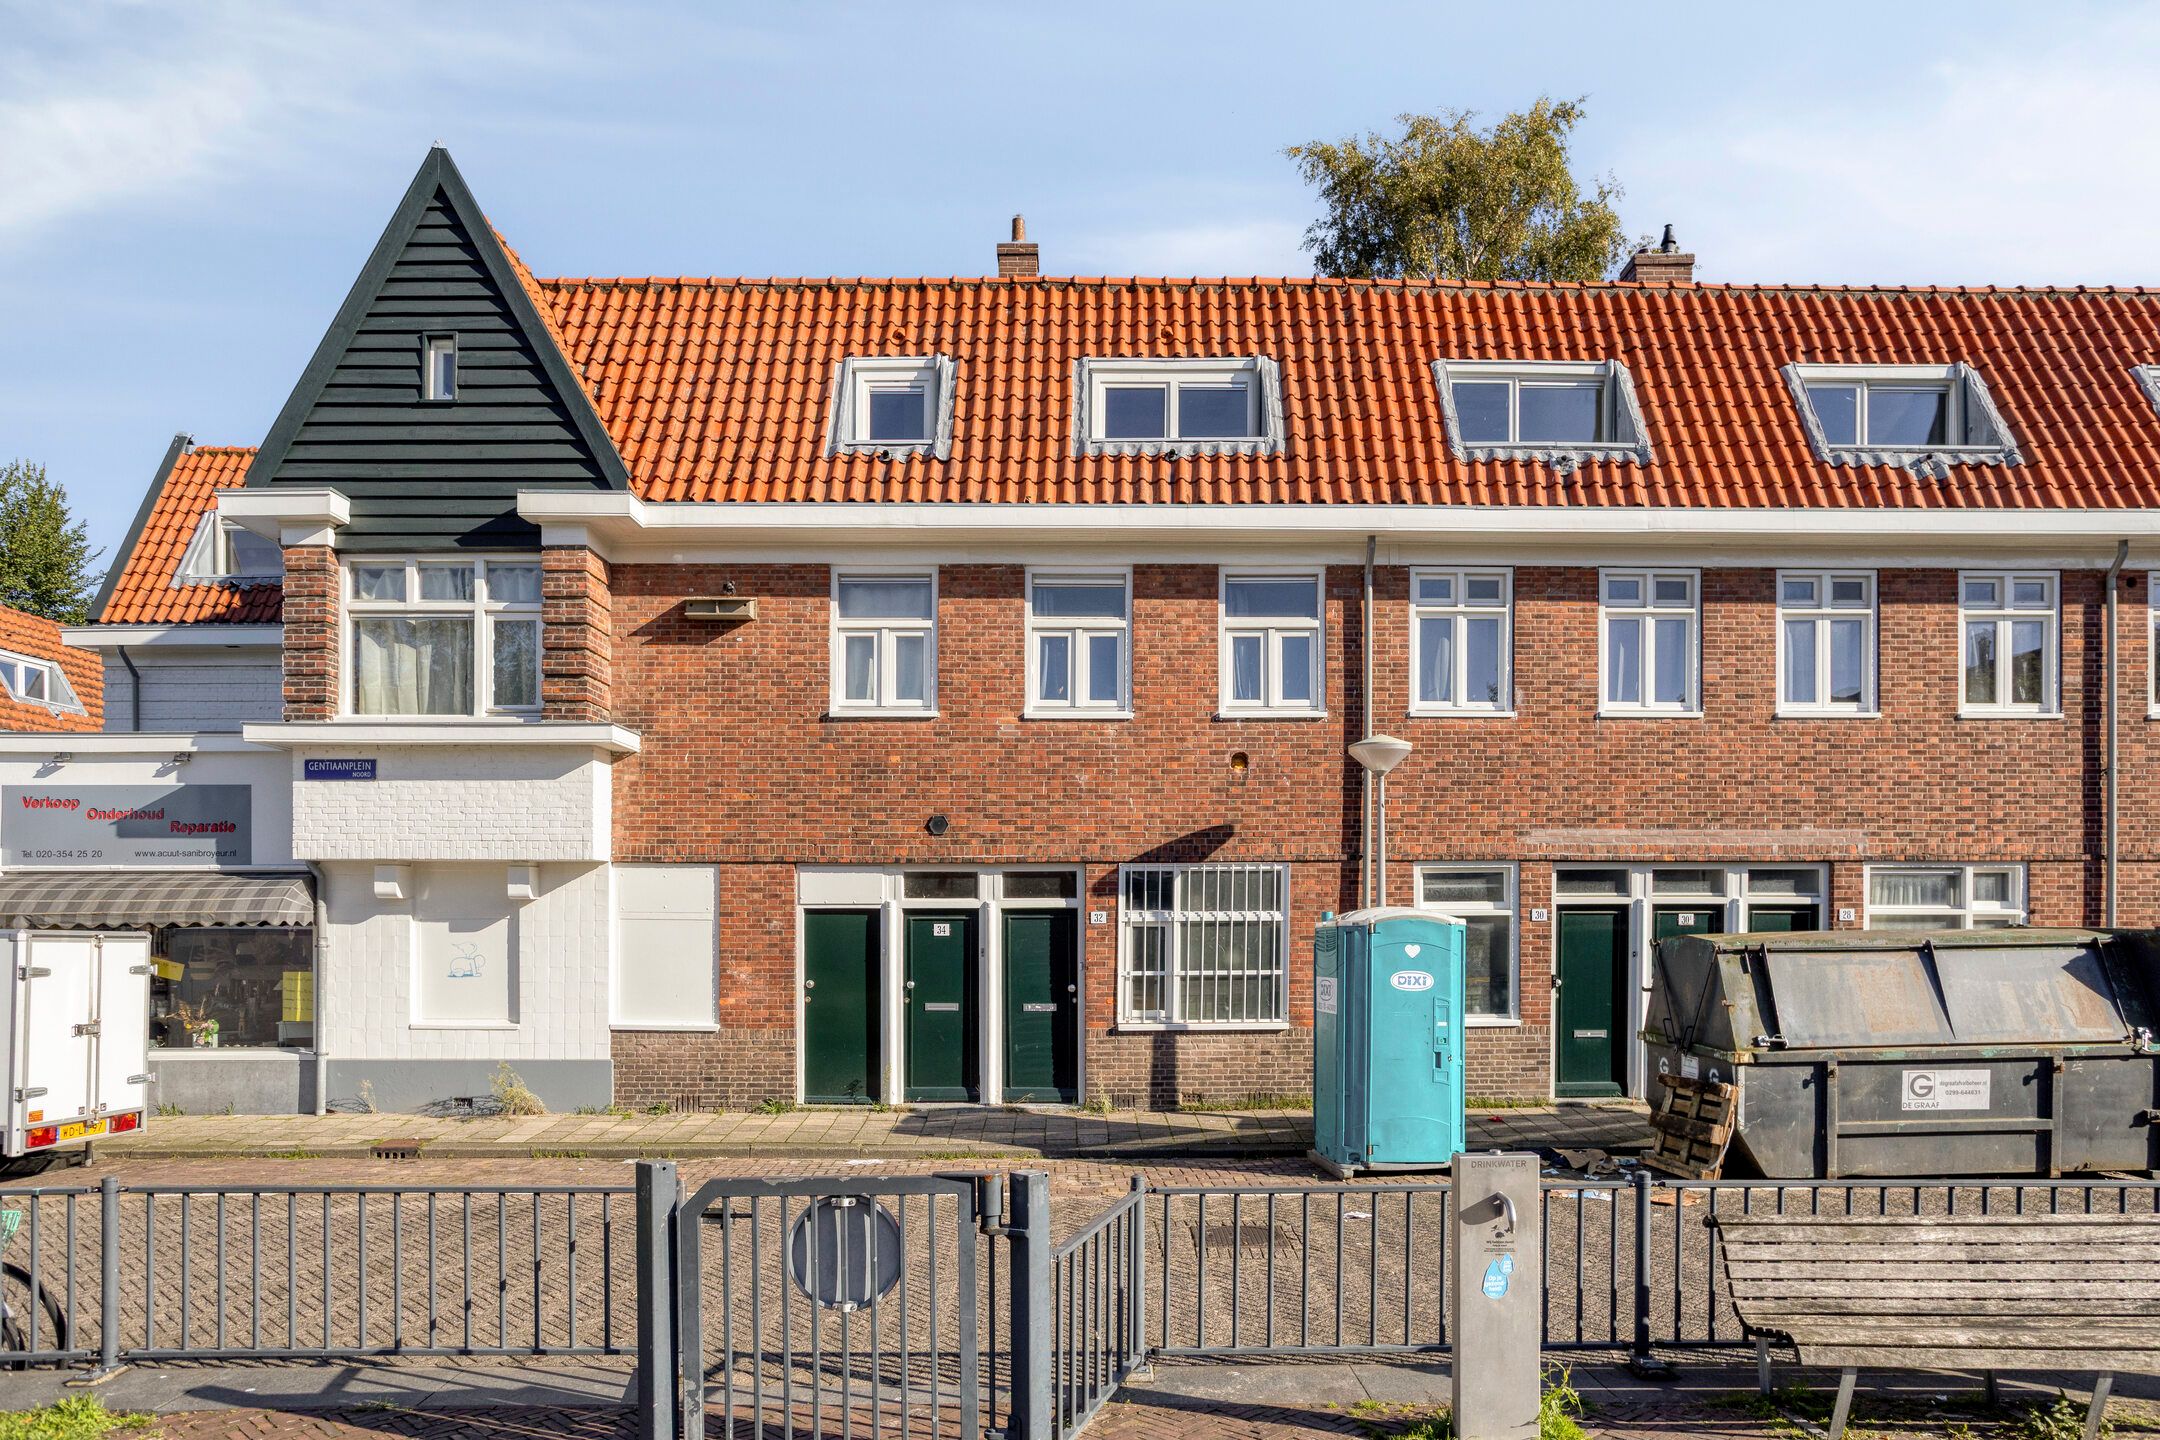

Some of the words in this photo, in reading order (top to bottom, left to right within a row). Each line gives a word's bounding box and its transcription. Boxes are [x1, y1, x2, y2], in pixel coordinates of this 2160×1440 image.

[308, 761, 372, 771] GENTIAANPLEIN
[22, 796, 80, 811] Verkoop
[86, 808, 164, 820] Onderhoud
[170, 820, 236, 835] Reparatie
[36, 850, 73, 858] 020-354
[77, 850, 88, 858] 25
[91, 850, 103, 858] 20
[135, 849, 237, 858] www.acuut-sanibroyeur.nl
[1093, 913, 1103, 922] 32
[1535, 910, 1544, 920] 30
[1842, 910, 1852, 920] 28
[936, 925, 946, 935] 34
[1902, 1101, 1912, 1109] DE
[1913, 1101, 1940, 1109] GRAAF
[1471, 1160, 1527, 1169] DRINKWATER
